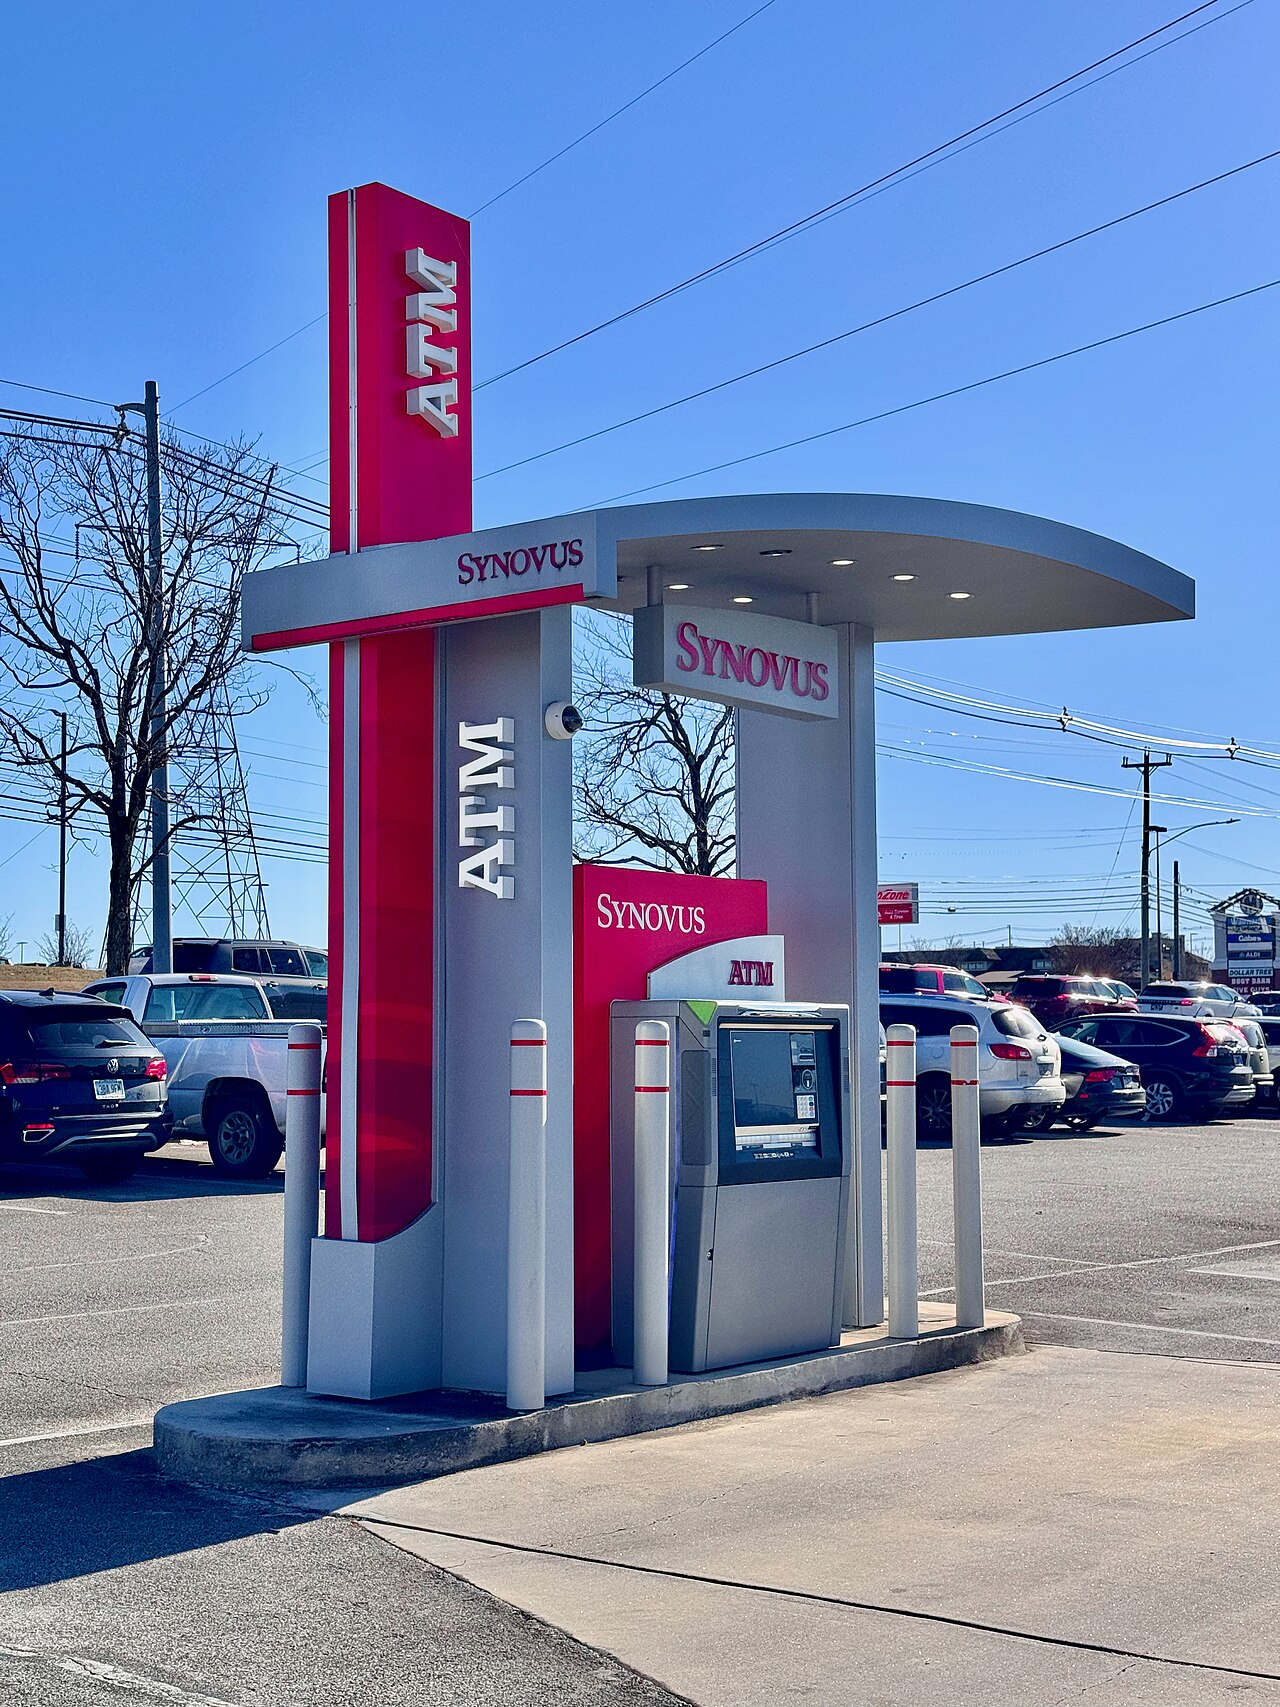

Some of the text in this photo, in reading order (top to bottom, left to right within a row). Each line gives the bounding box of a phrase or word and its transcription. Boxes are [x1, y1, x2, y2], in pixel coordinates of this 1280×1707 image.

[405, 246, 458, 439] ATM
[457, 538, 584, 585] SYNOVUS
[676, 621, 830, 701] SYNOVUS
[458, 717, 515, 900] ATM
[596, 893, 706, 934] SYNOVUS
[727, 959, 774, 987] ATM
[1231, 977, 1271, 985] BOOT BARN
[1255, 968, 1272, 976] TREE
